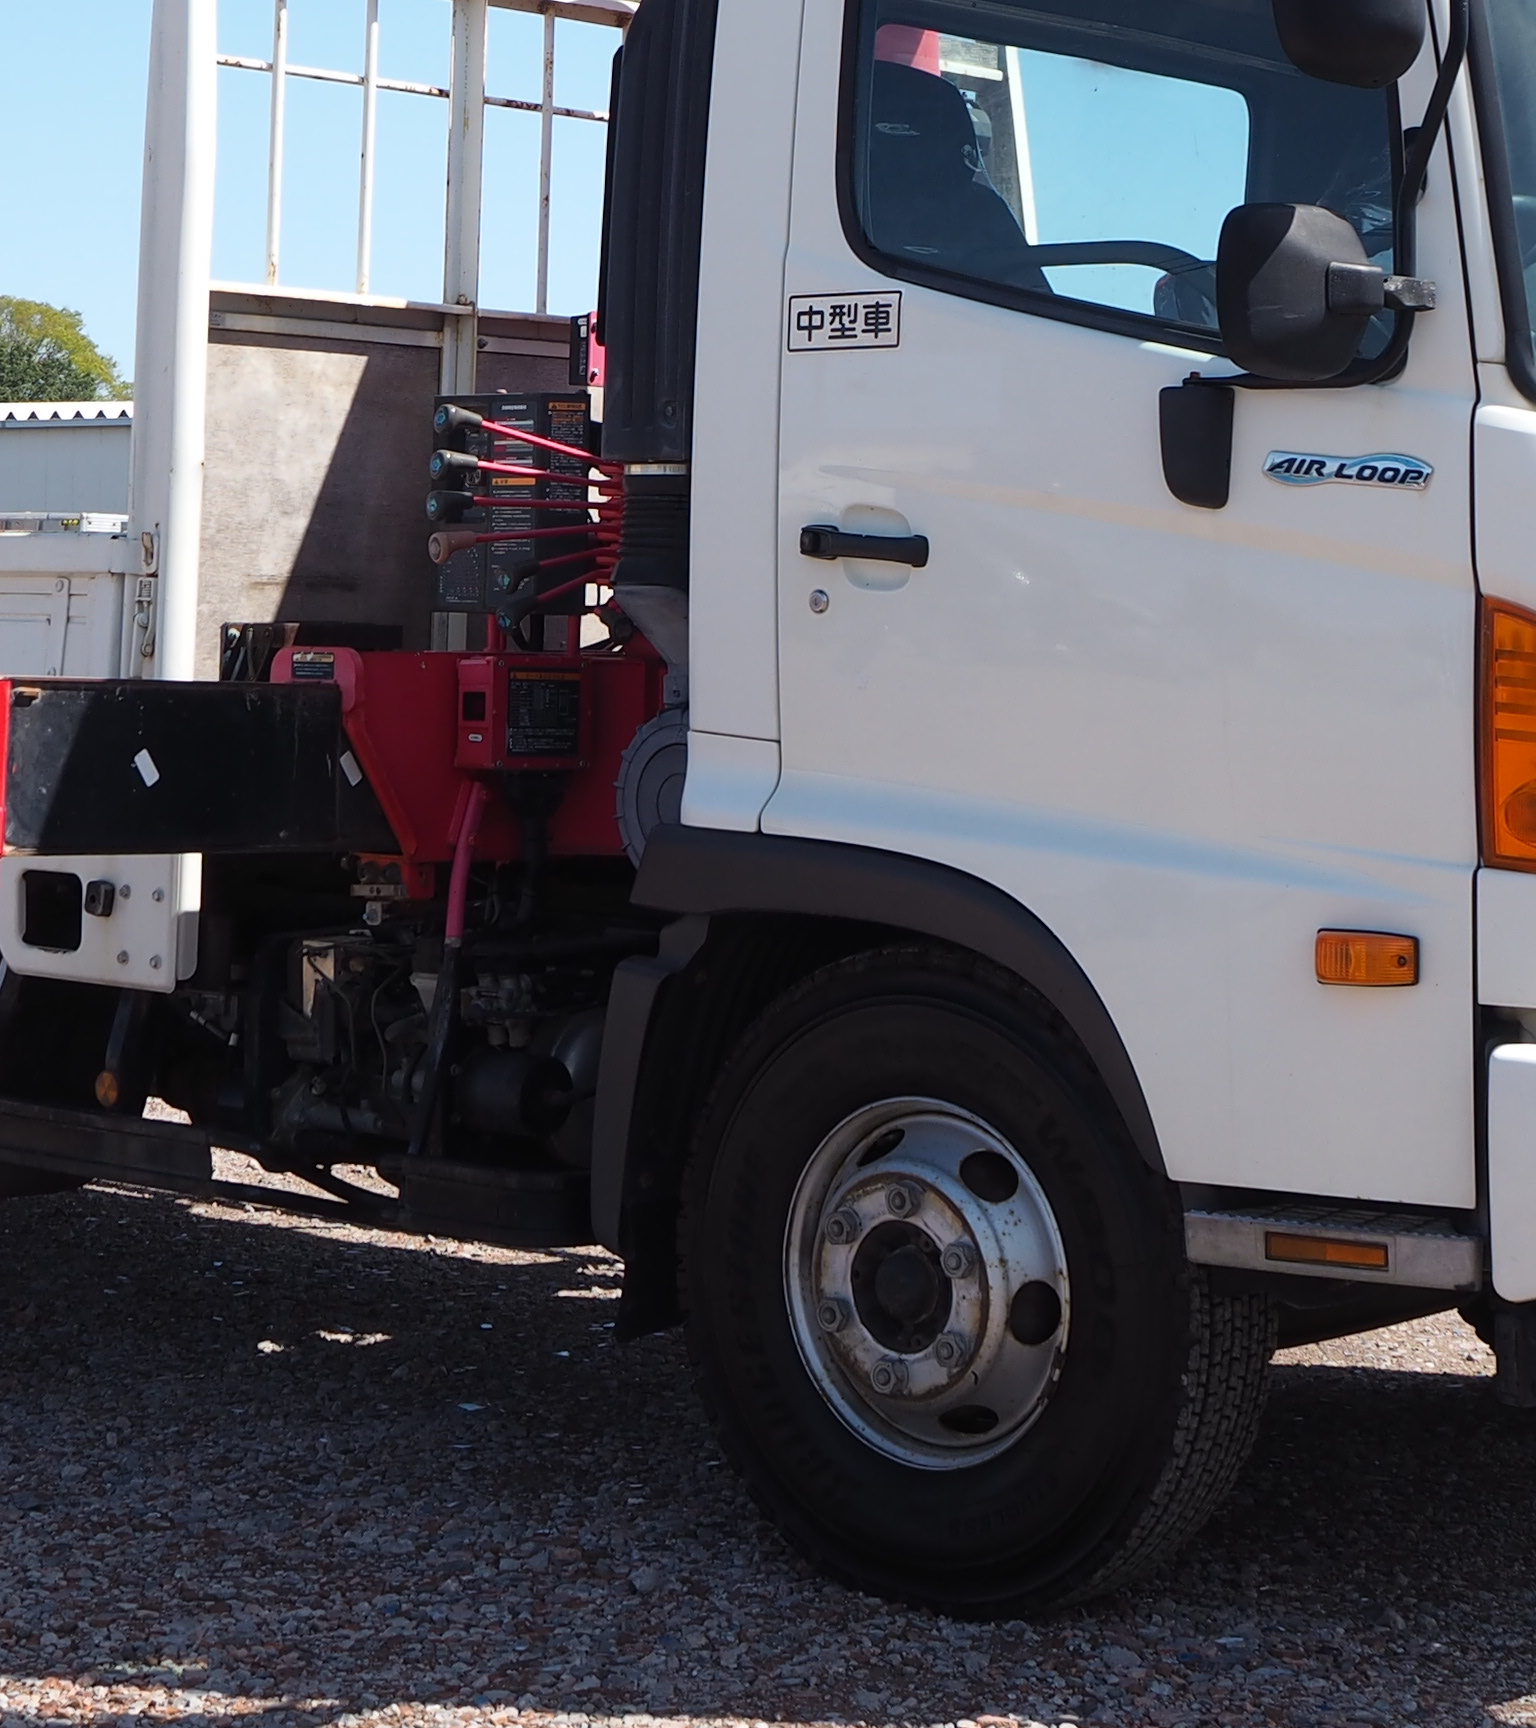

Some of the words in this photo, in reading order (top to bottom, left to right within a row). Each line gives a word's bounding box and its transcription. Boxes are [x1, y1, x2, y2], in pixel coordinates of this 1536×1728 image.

[796, 300, 893, 343] 中型車
[1266, 457, 1328, 478] AIR
[1334, 462, 1426, 485] LOOP
